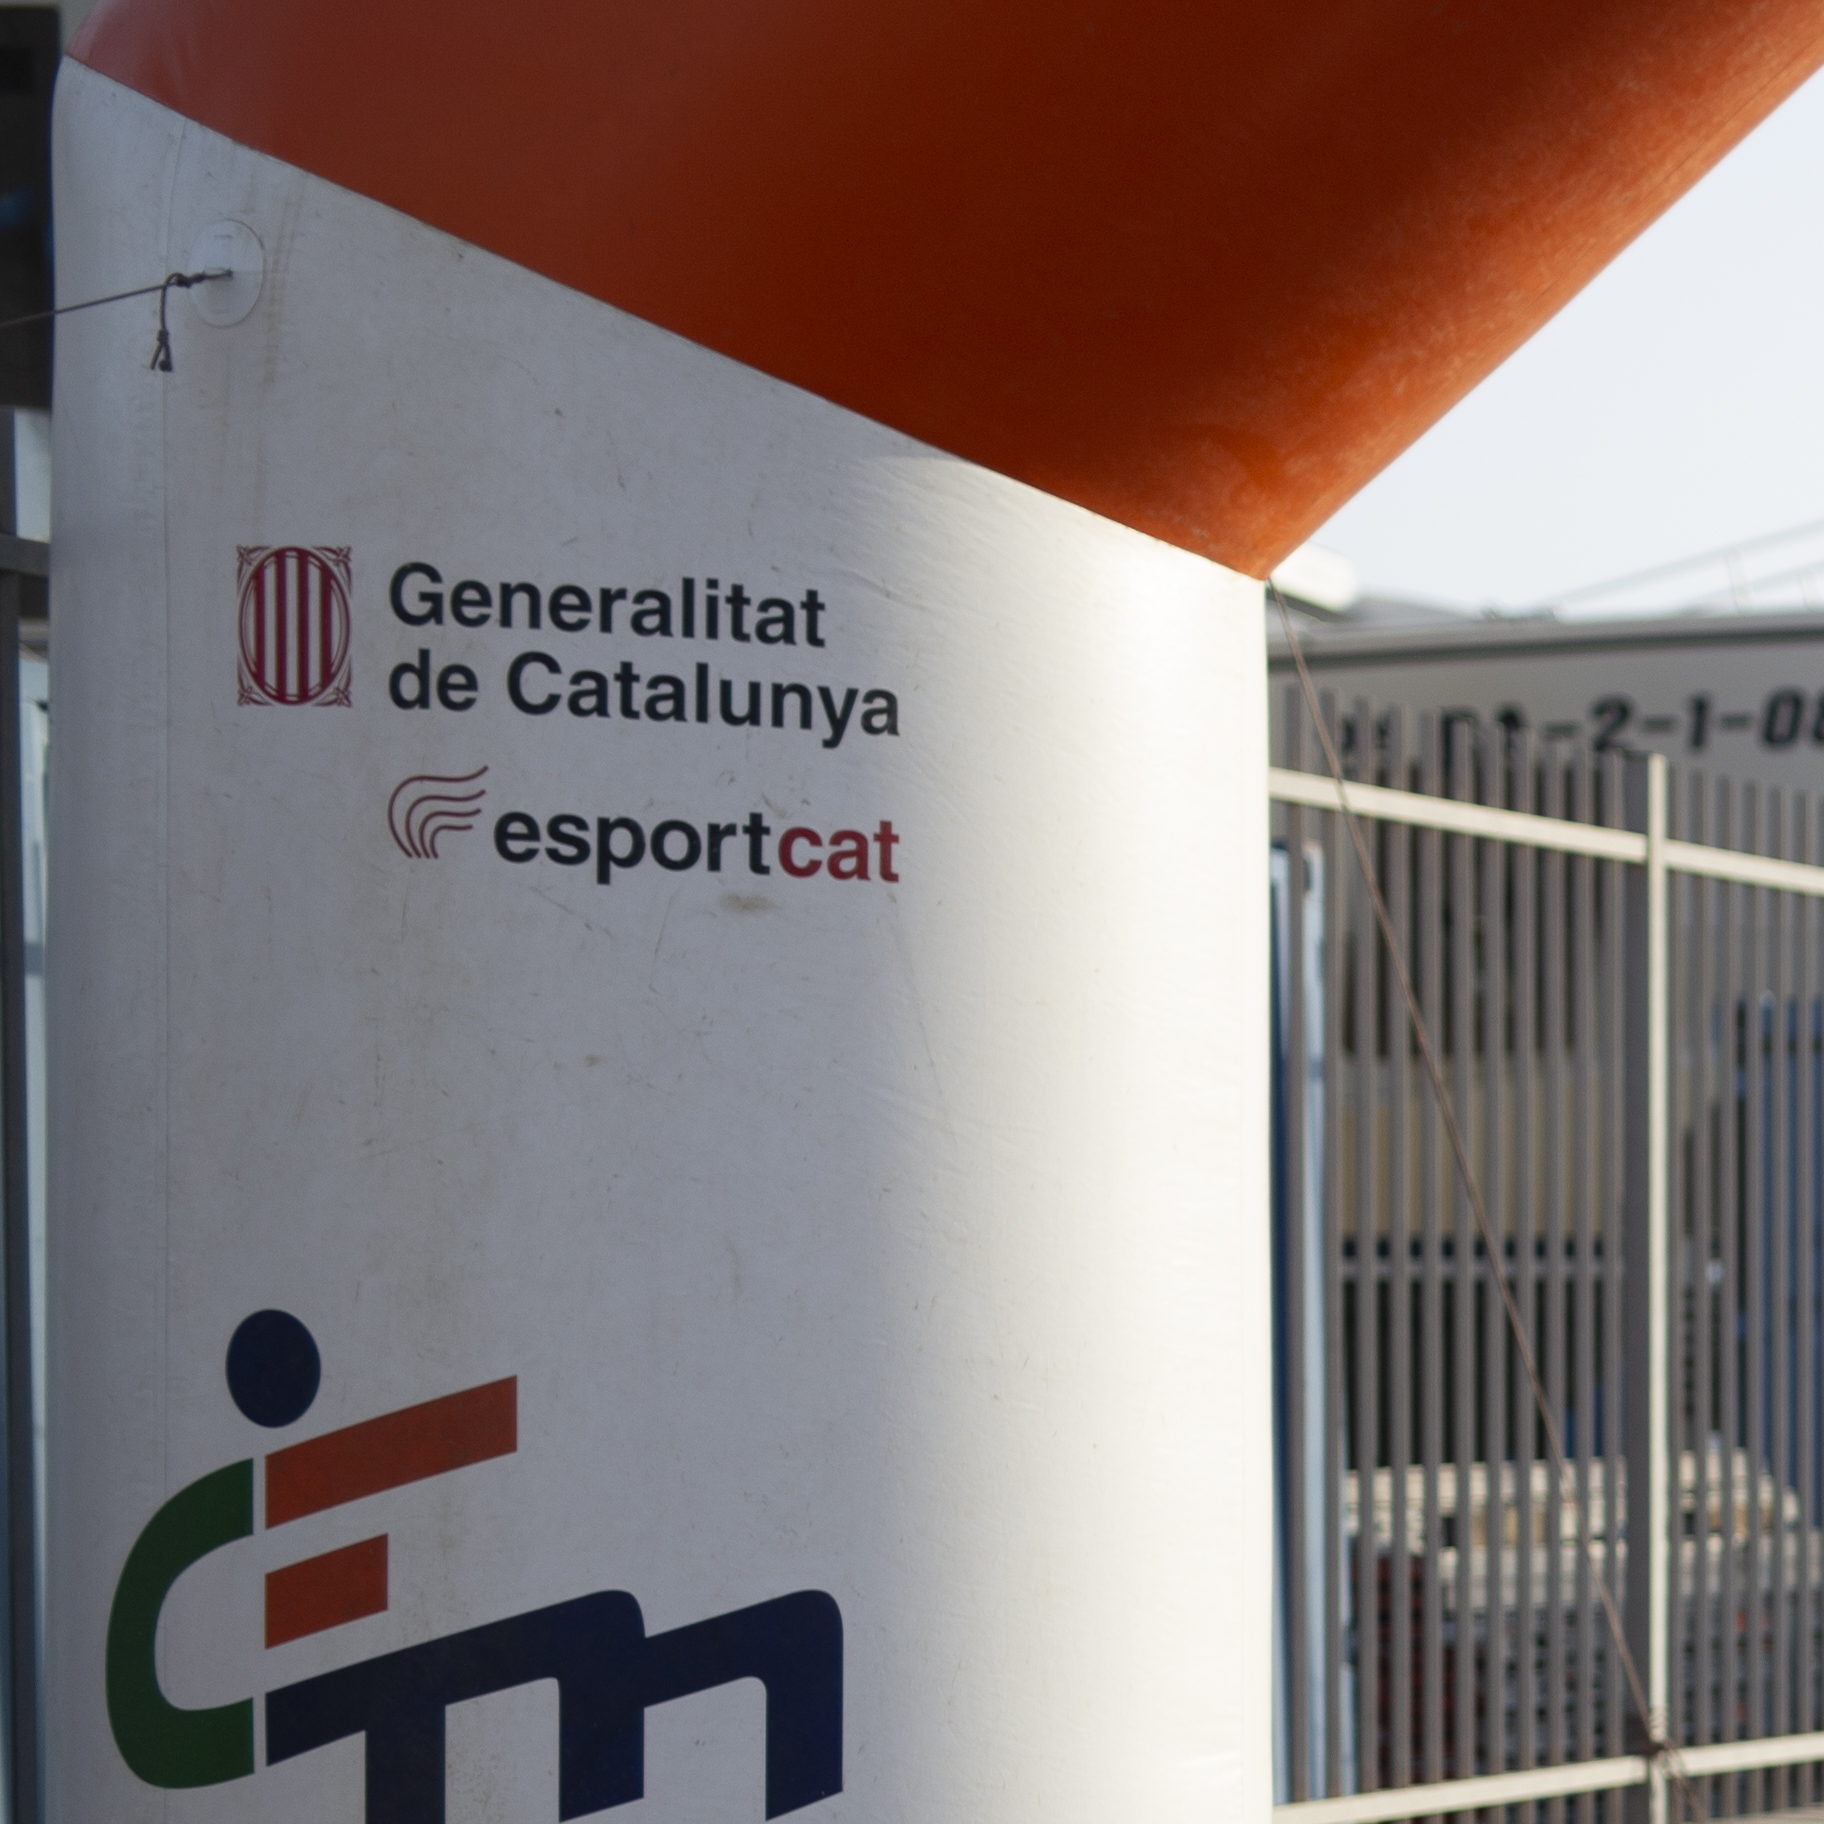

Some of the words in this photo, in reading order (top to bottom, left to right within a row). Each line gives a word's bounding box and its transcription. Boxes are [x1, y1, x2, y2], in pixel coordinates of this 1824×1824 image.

[388, 560, 827, 649] Generalitat
[387, 647, 480, 713] de
[505, 649, 901, 751] Catalunya
[492, 810, 901, 887] esportcat
